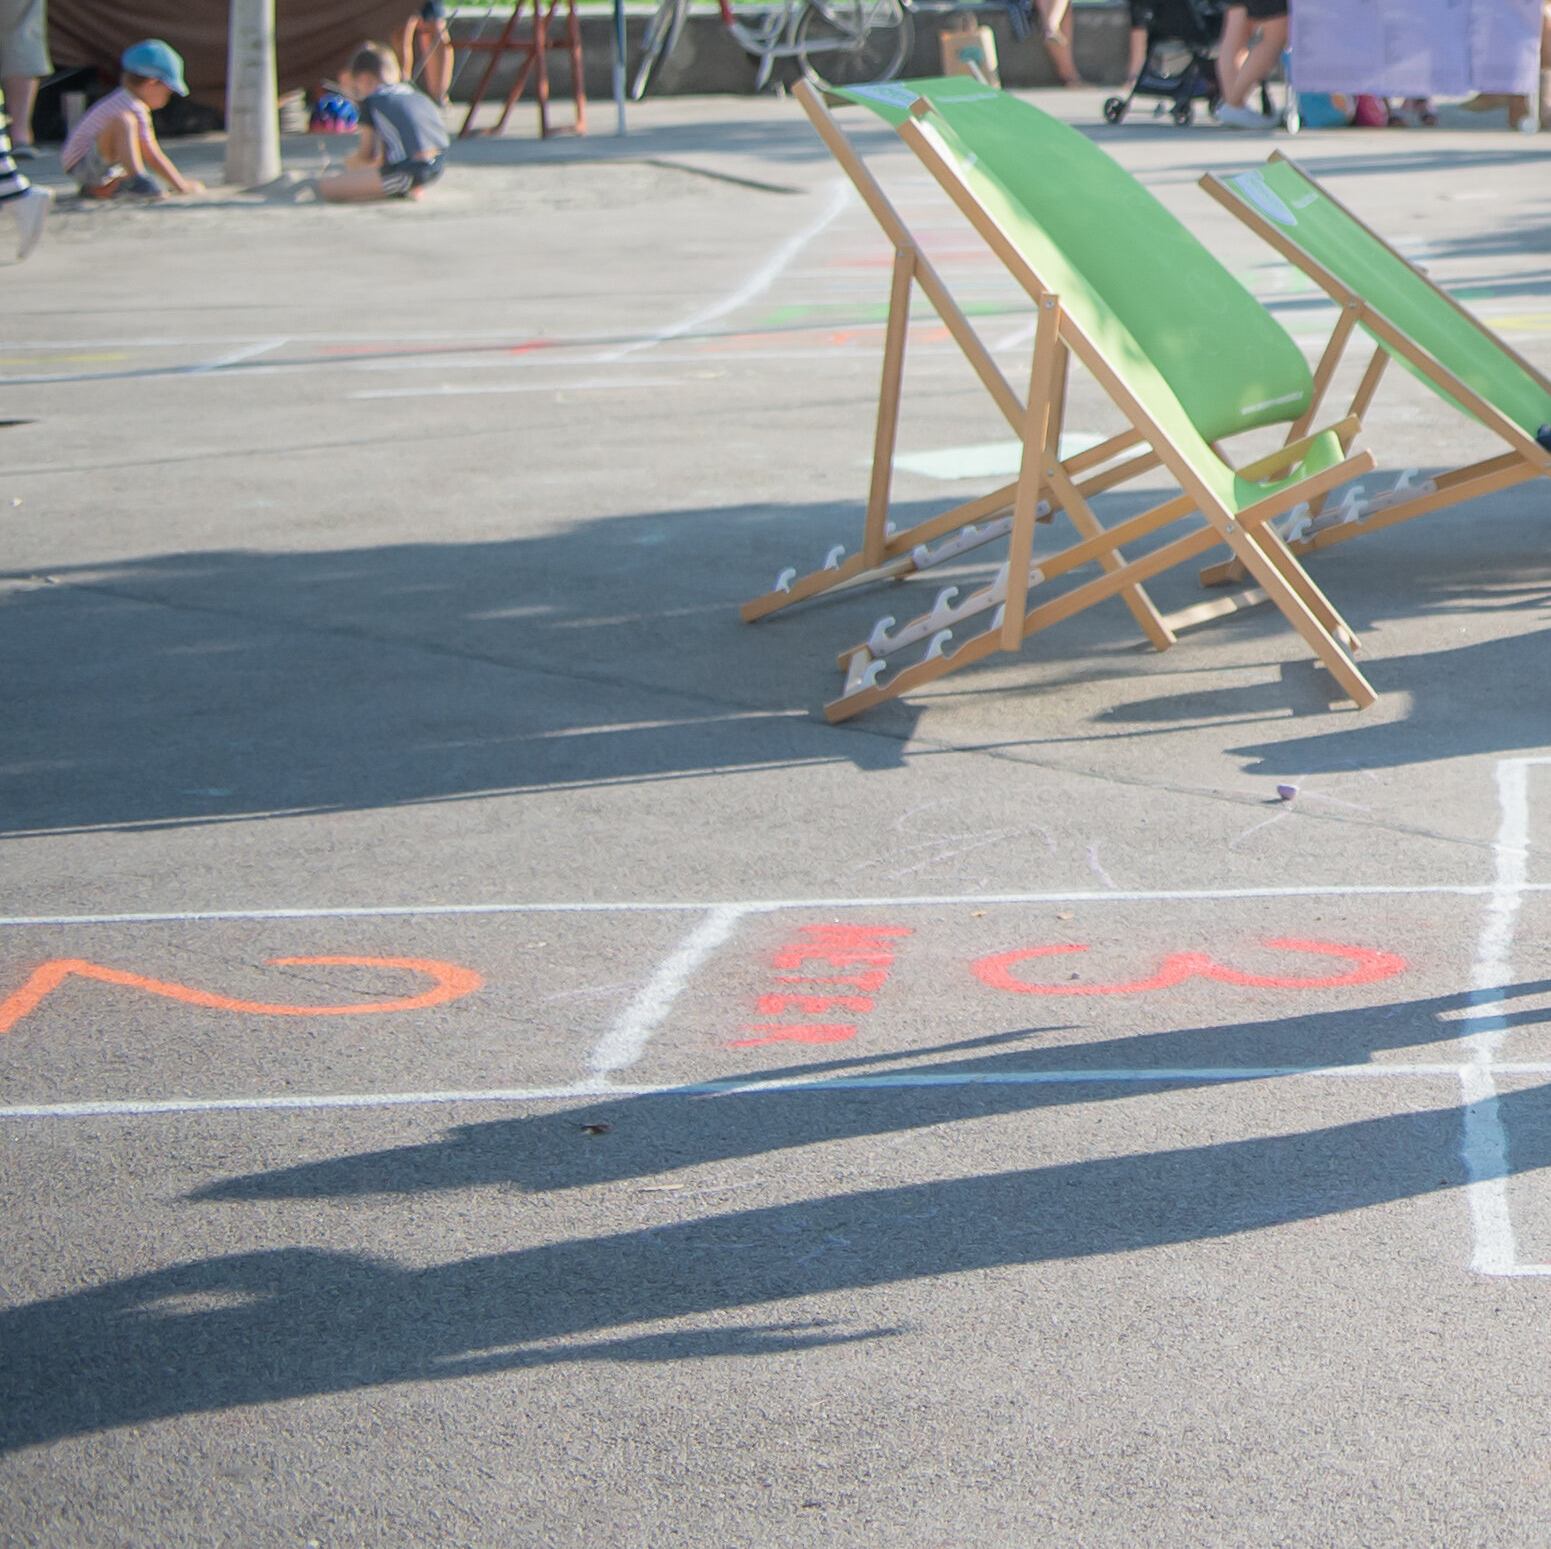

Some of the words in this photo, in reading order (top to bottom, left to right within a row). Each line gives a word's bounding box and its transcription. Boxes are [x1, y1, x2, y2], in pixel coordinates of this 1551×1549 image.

[0, 957, 484, 1034] 2
[731, 925, 915, 1047] METER
[968, 937, 1407, 996] 3
